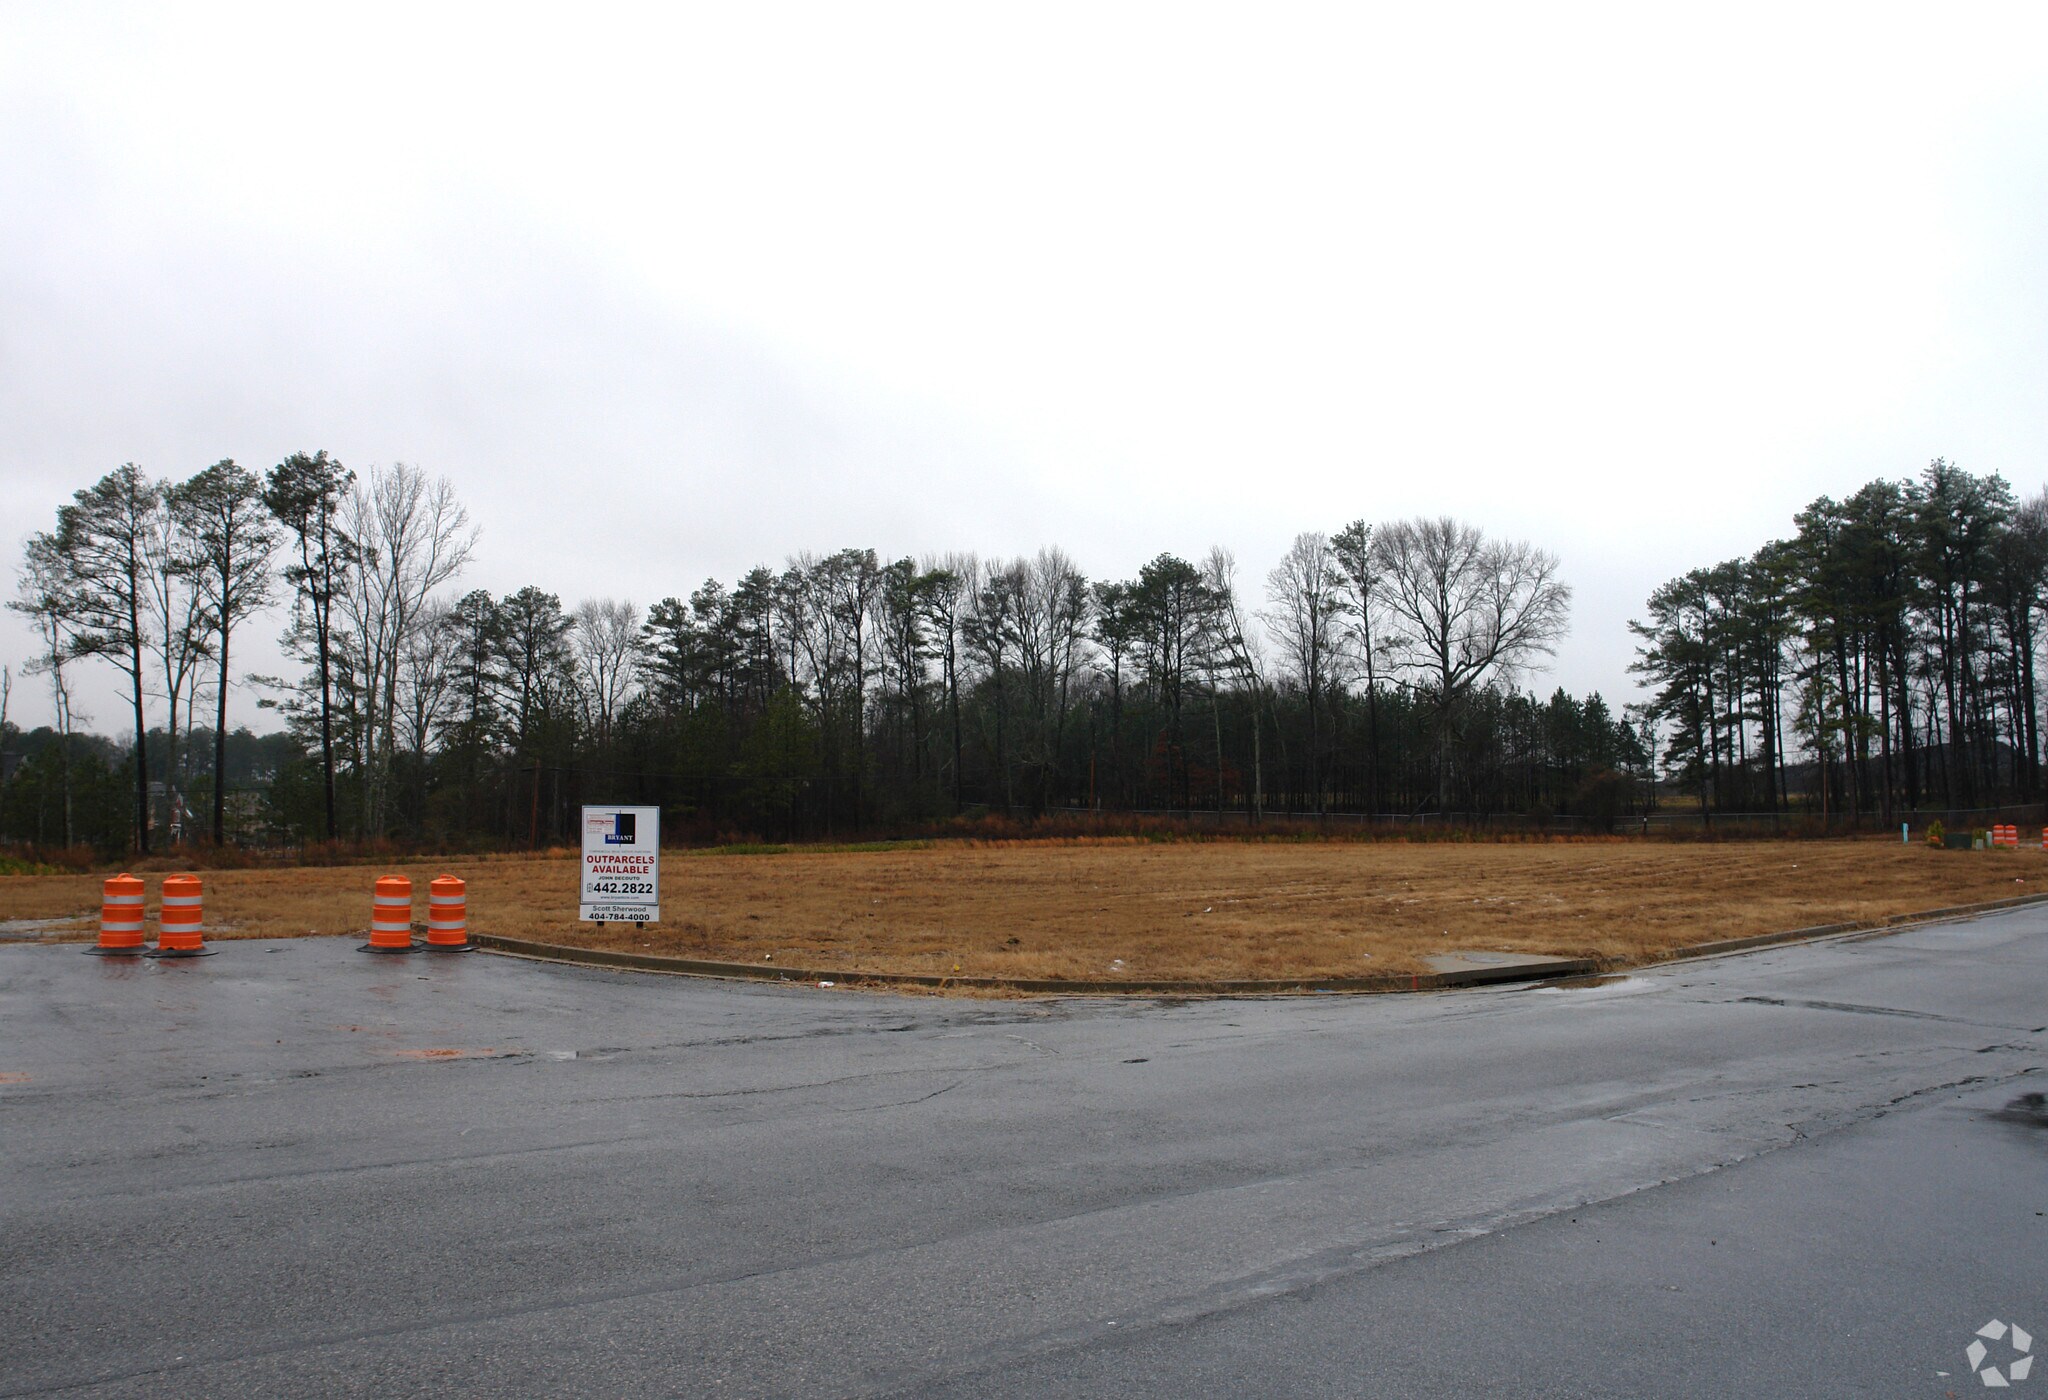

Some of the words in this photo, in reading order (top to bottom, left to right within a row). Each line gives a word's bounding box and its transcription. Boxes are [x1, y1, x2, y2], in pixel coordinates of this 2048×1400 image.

[586, 855, 655, 864] OUTPARCELS
[592, 866, 649, 874] AVAILABLE
[593, 882, 653, 894] 442.2822
